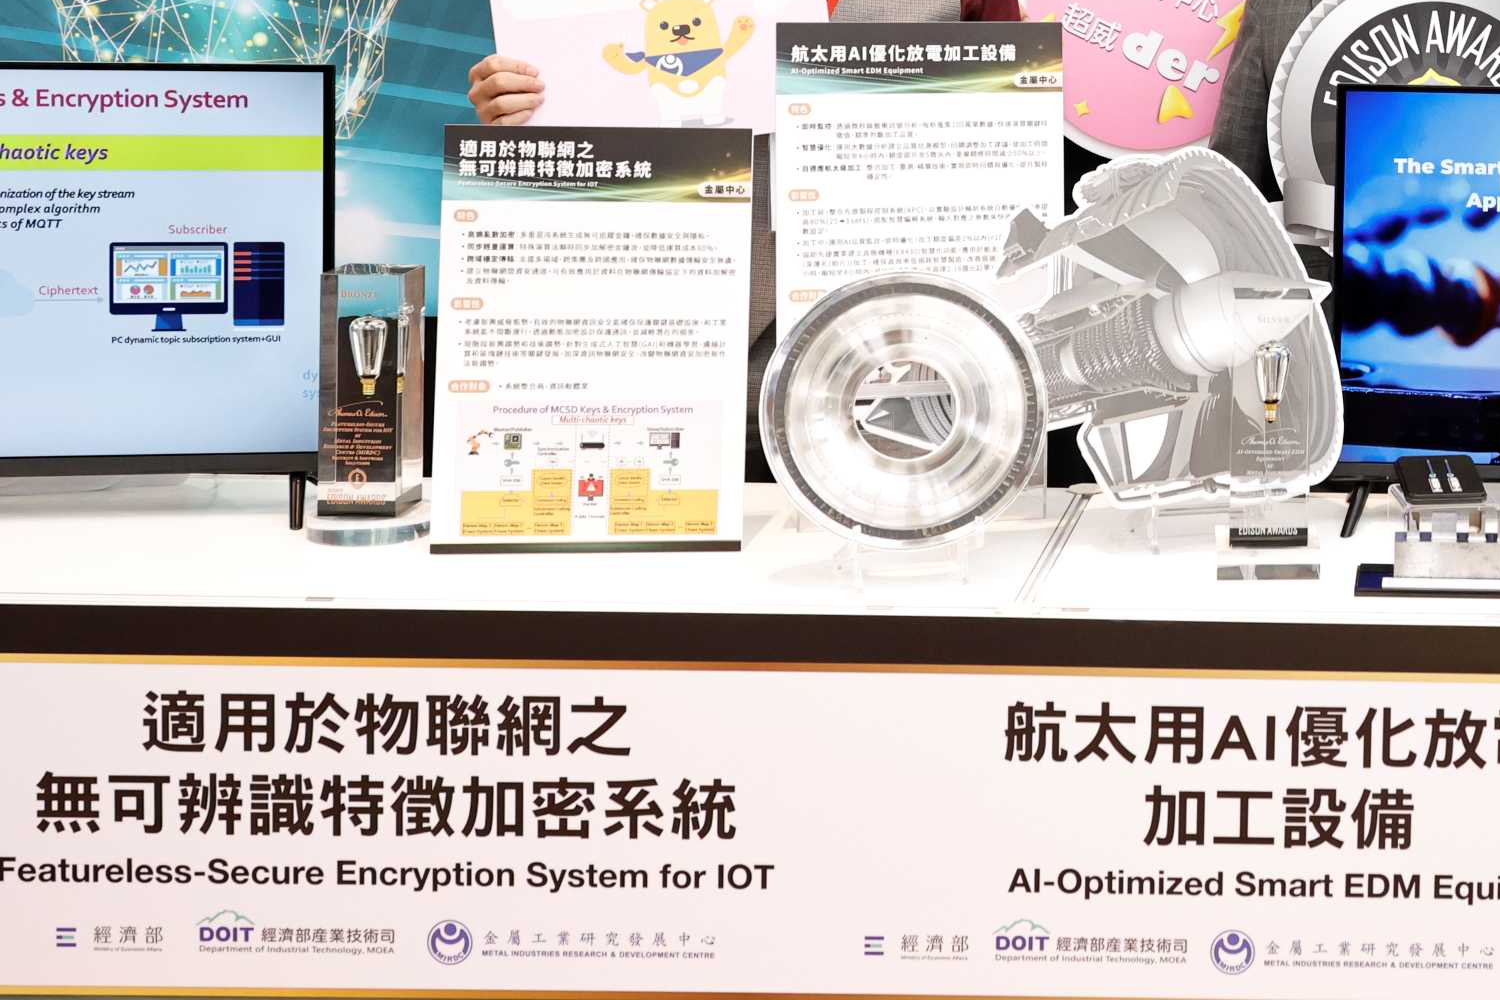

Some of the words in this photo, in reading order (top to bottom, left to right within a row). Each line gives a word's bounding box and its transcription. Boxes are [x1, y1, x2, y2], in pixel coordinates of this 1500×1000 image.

[791, 44, 1017, 63] 航太用AI優化放電加工設備
[841, 67, 865, 75] Smart
[866, 67, 882, 75] EDM
[883, 67, 923, 76] Equipment
[1019, 75, 1057, 84] 金屬中心
[11, 88, 29, 107] &
[36, 88, 159, 113] Encryption
[164, 90, 249, 113] System
[65, 144, 108, 164] keys
[459, 140, 594, 159] 適用於物聯網之
[459, 159, 652, 179] 無可辨識特徵加密系統
[1394, 158, 1434, 176] The
[44, 188, 57, 200] of
[57, 188, 76, 199] the
[77, 188, 96, 201] key
[97, 189, 135, 199] stream
[704, 184, 746, 195] 金屬中心
[43, 204, 101, 215] algorithm
[10, 219, 24, 231] of
[25, 219, 63, 230] MQTT
[168, 224, 228, 235] Subscriber
[39, 285, 99, 297] Ciphertext
[111, 336, 123, 344] PC
[125, 335, 160, 344] dynamic
[160, 335, 181, 344] topic
[182, 335, 231, 344] subscription
[493, 405, 538, 414] Procedure
[539, 405, 549, 414] of
[551, 405, 578, 414] MCSD
[580, 406, 600, 415] Keys
[612, 405, 659, 416] Encryption
[660, 406, 694, 415] System
[142, 690, 631, 757] 適用於物聯網之
[35, 770, 736, 841] 無可辨識特徵加密系統
[1143, 784, 1415, 849] 加工設備
[0, 856, 325, 886] Featureless-Secure
[336, 858, 516, 892] Encryption
[526, 861, 649, 894] System
[660, 862, 707, 889] for
[717, 865, 776, 890] IOT
[1008, 867, 1224, 901] AI-Optimized
[1235, 871, 1334, 898] Smart
[1344, 873, 1422, 899] EDM
[93, 925, 164, 944] 經濟部
[199, 926, 255, 943] DOIT
[261, 927, 395, 944] 經濟部產業技術司
[483, 929, 716, 947] 金屬工業研究發展中心
[995, 935, 1050, 951] DOIT
[199, 944, 252, 954] Department
[255, 944, 264, 953] of
[267, 945, 310, 954] Industrial
[367, 946, 395, 954] MOEA
[900, 934, 969, 953] 經濟部
[1056, 936, 1188, 954] 經濟部產業技術司
[1266, 940, 1495, 957] 金屬工業研究發展中心
[511, 950, 561, 958] INDUSTRIES
[562, 950, 608, 958] RESEARCH
[619, 951, 680, 959] DEVELOPMENT
[682, 951, 716, 959] CENTRE
[995, 953, 1048, 963] Department
[1050, 954, 1060, 963] of
[1061, 954, 1104, 963] Industrial
[1160, 956, 1187, 964] MOEA
[1263, 959, 1291, 967] METAL
[1292, 960, 1341, 968] INDUSTRIES
[1343, 960, 1388, 968] RESEARCH
[1398, 961, 1459, 969] DEVELOPMENT
[1461, 961, 1494, 970] CENTRE
